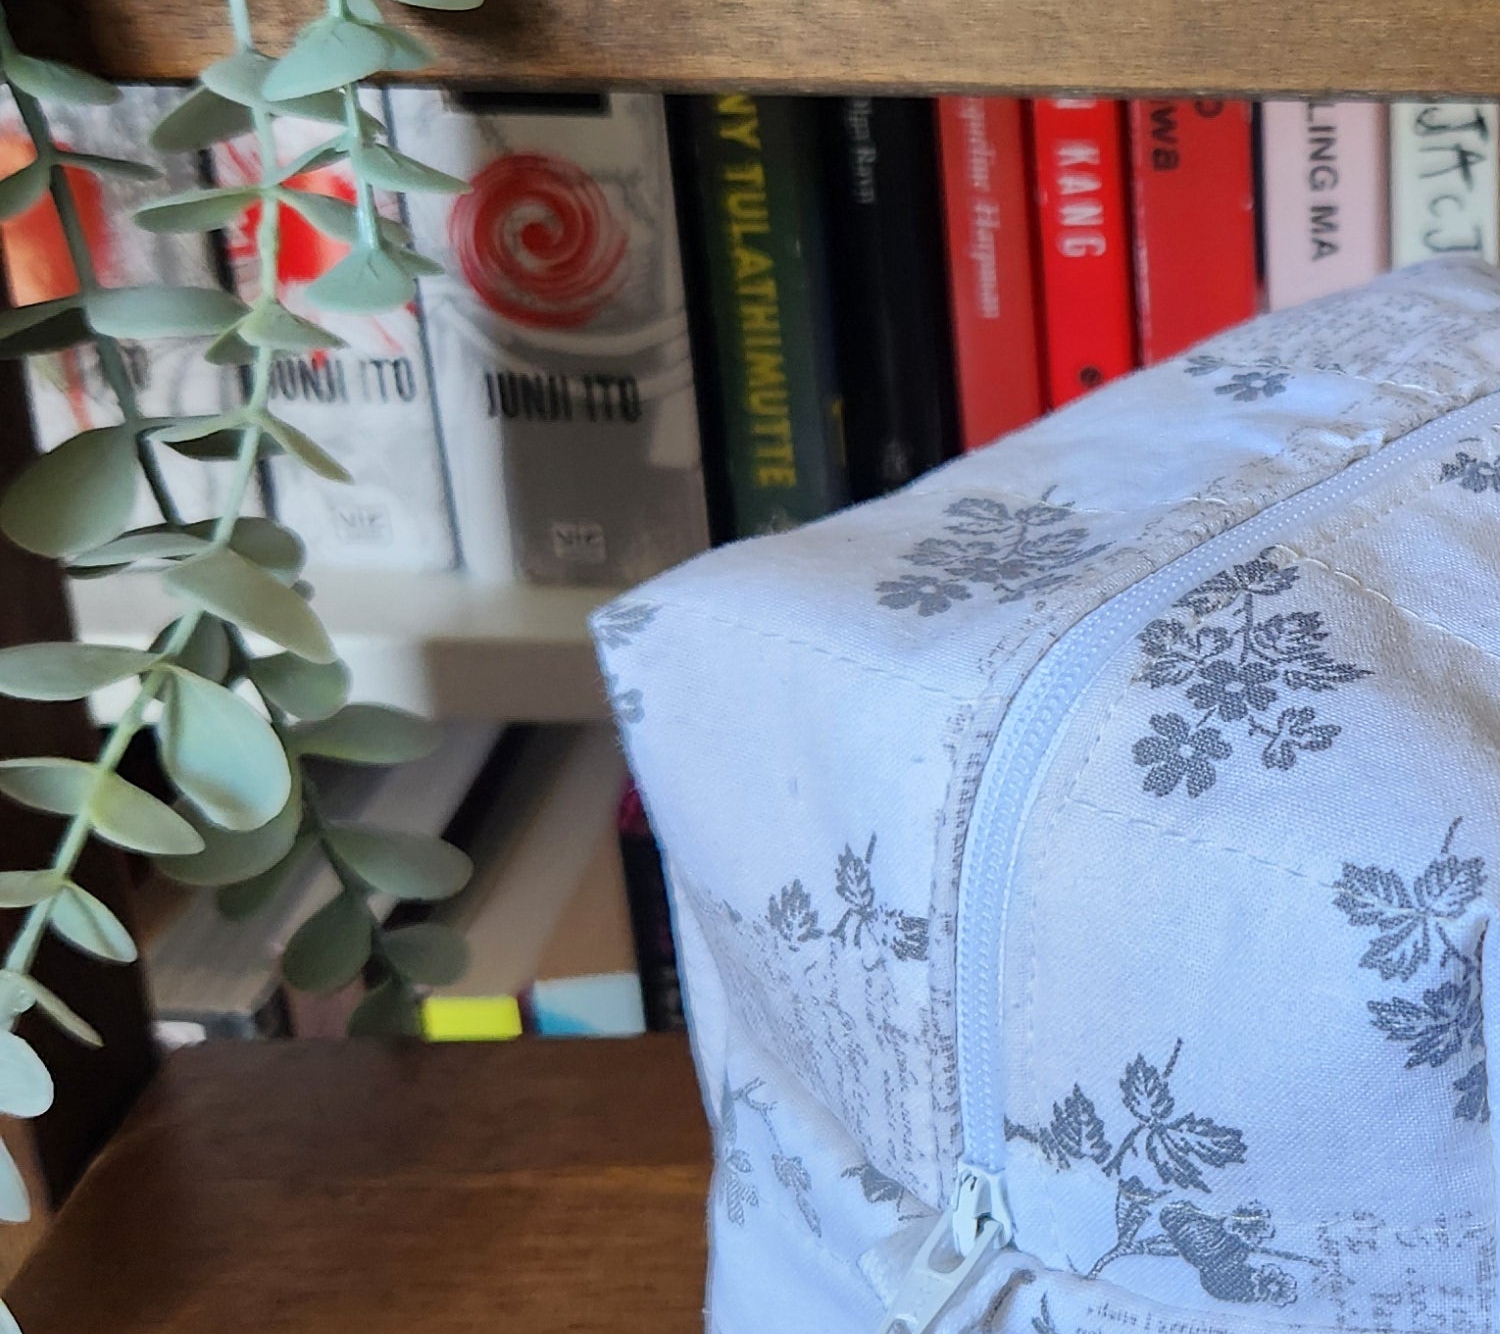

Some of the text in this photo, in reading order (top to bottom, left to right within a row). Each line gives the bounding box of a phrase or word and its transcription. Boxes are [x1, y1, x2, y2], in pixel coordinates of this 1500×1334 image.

[713, 95, 762, 150] NY
[1056, 145, 1108, 260] KANG
[1309, 205, 1342, 262] MA
[359, 356, 416, 404] ITO
[485, 371, 573, 420] JUNJI
